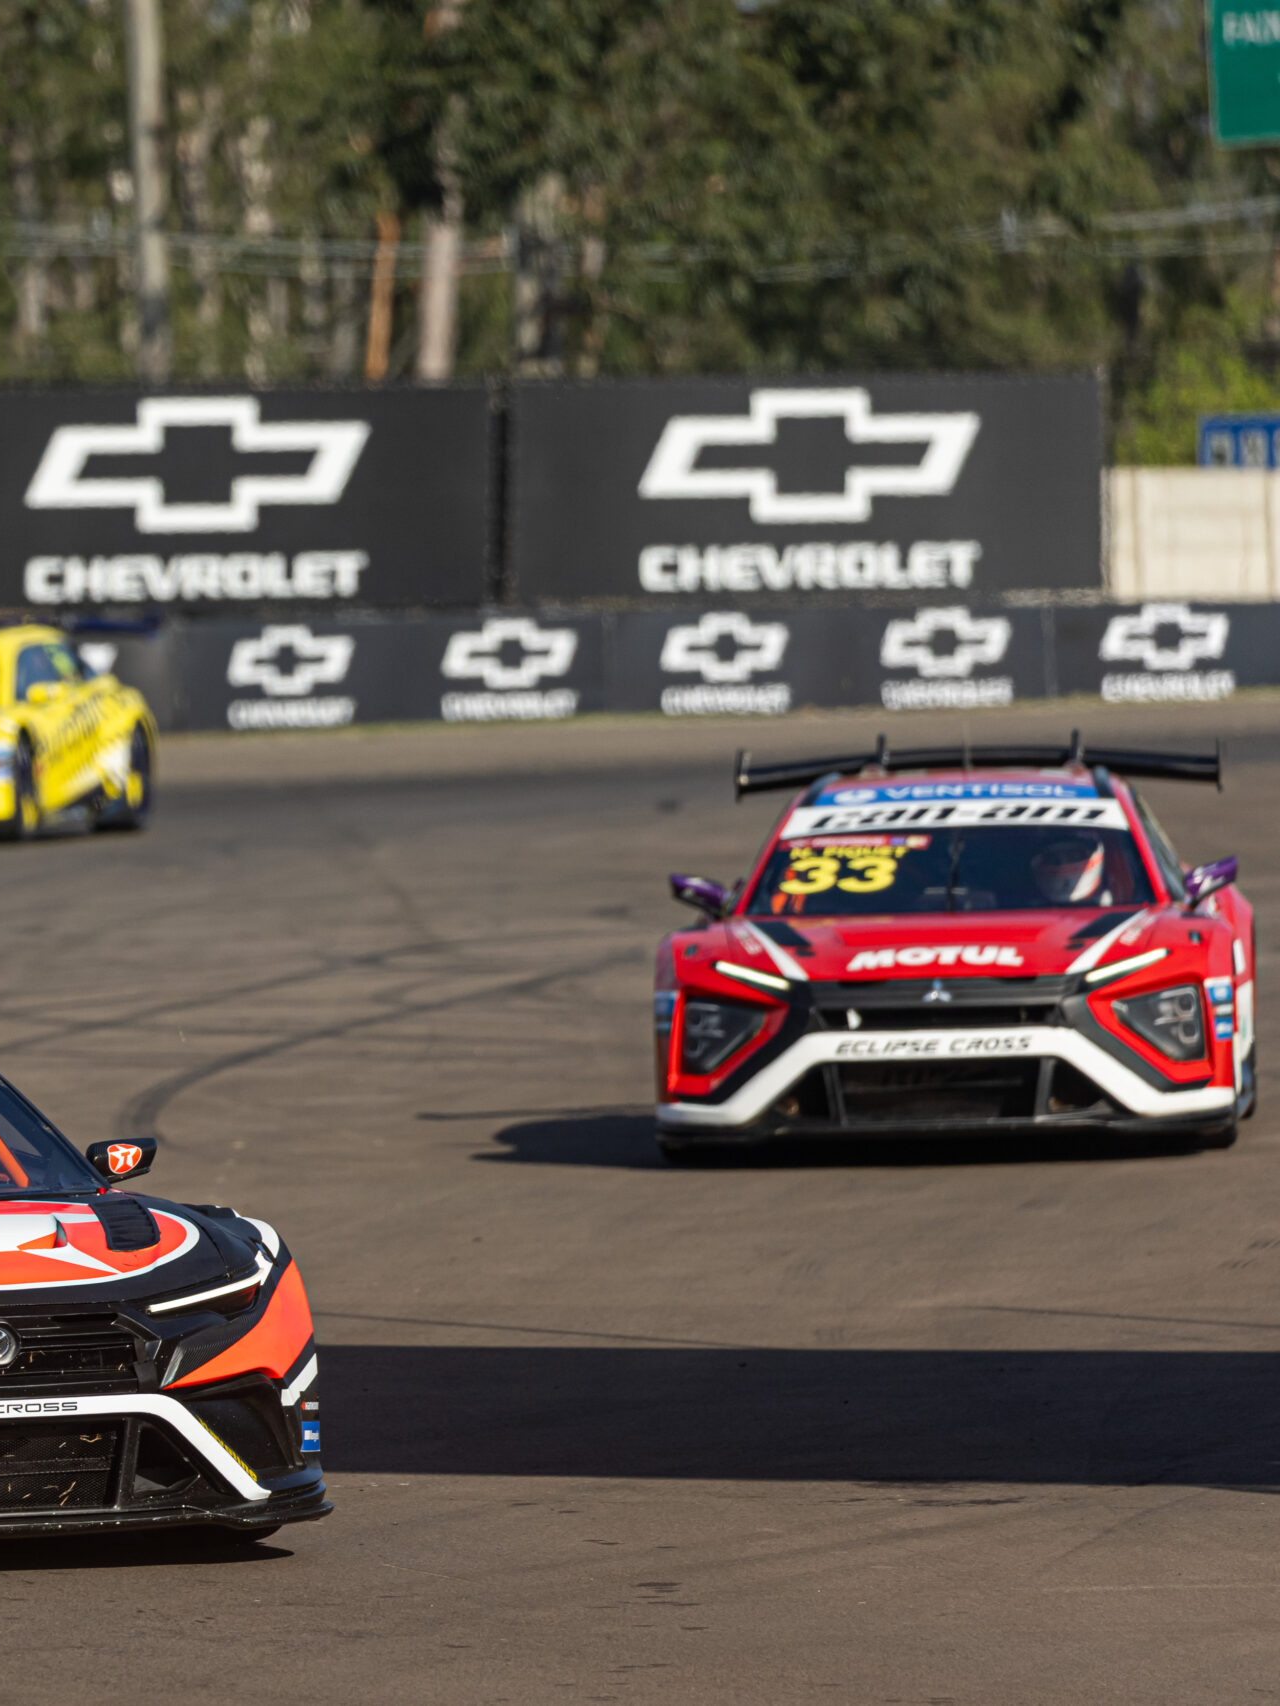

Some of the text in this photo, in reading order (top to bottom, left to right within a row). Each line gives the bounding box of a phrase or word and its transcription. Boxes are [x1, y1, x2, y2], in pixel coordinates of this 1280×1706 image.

[25, 550, 367, 603] CHEVROLET
[639, 540, 981, 592] CHEVROLET
[661, 684, 791, 715] CHEVROLET
[881, 677, 1013, 710] CHEVROLET
[1101, 670, 1235, 701] CHEVROLET
[228, 698, 354, 729] CHEVROLET
[441, 689, 578, 721] CHEVROLET
[779, 857, 898, 894] 33
[847, 946, 1023, 971] MOTUL
[836, 1035, 1034, 1055] ECLIPSE CROSS
